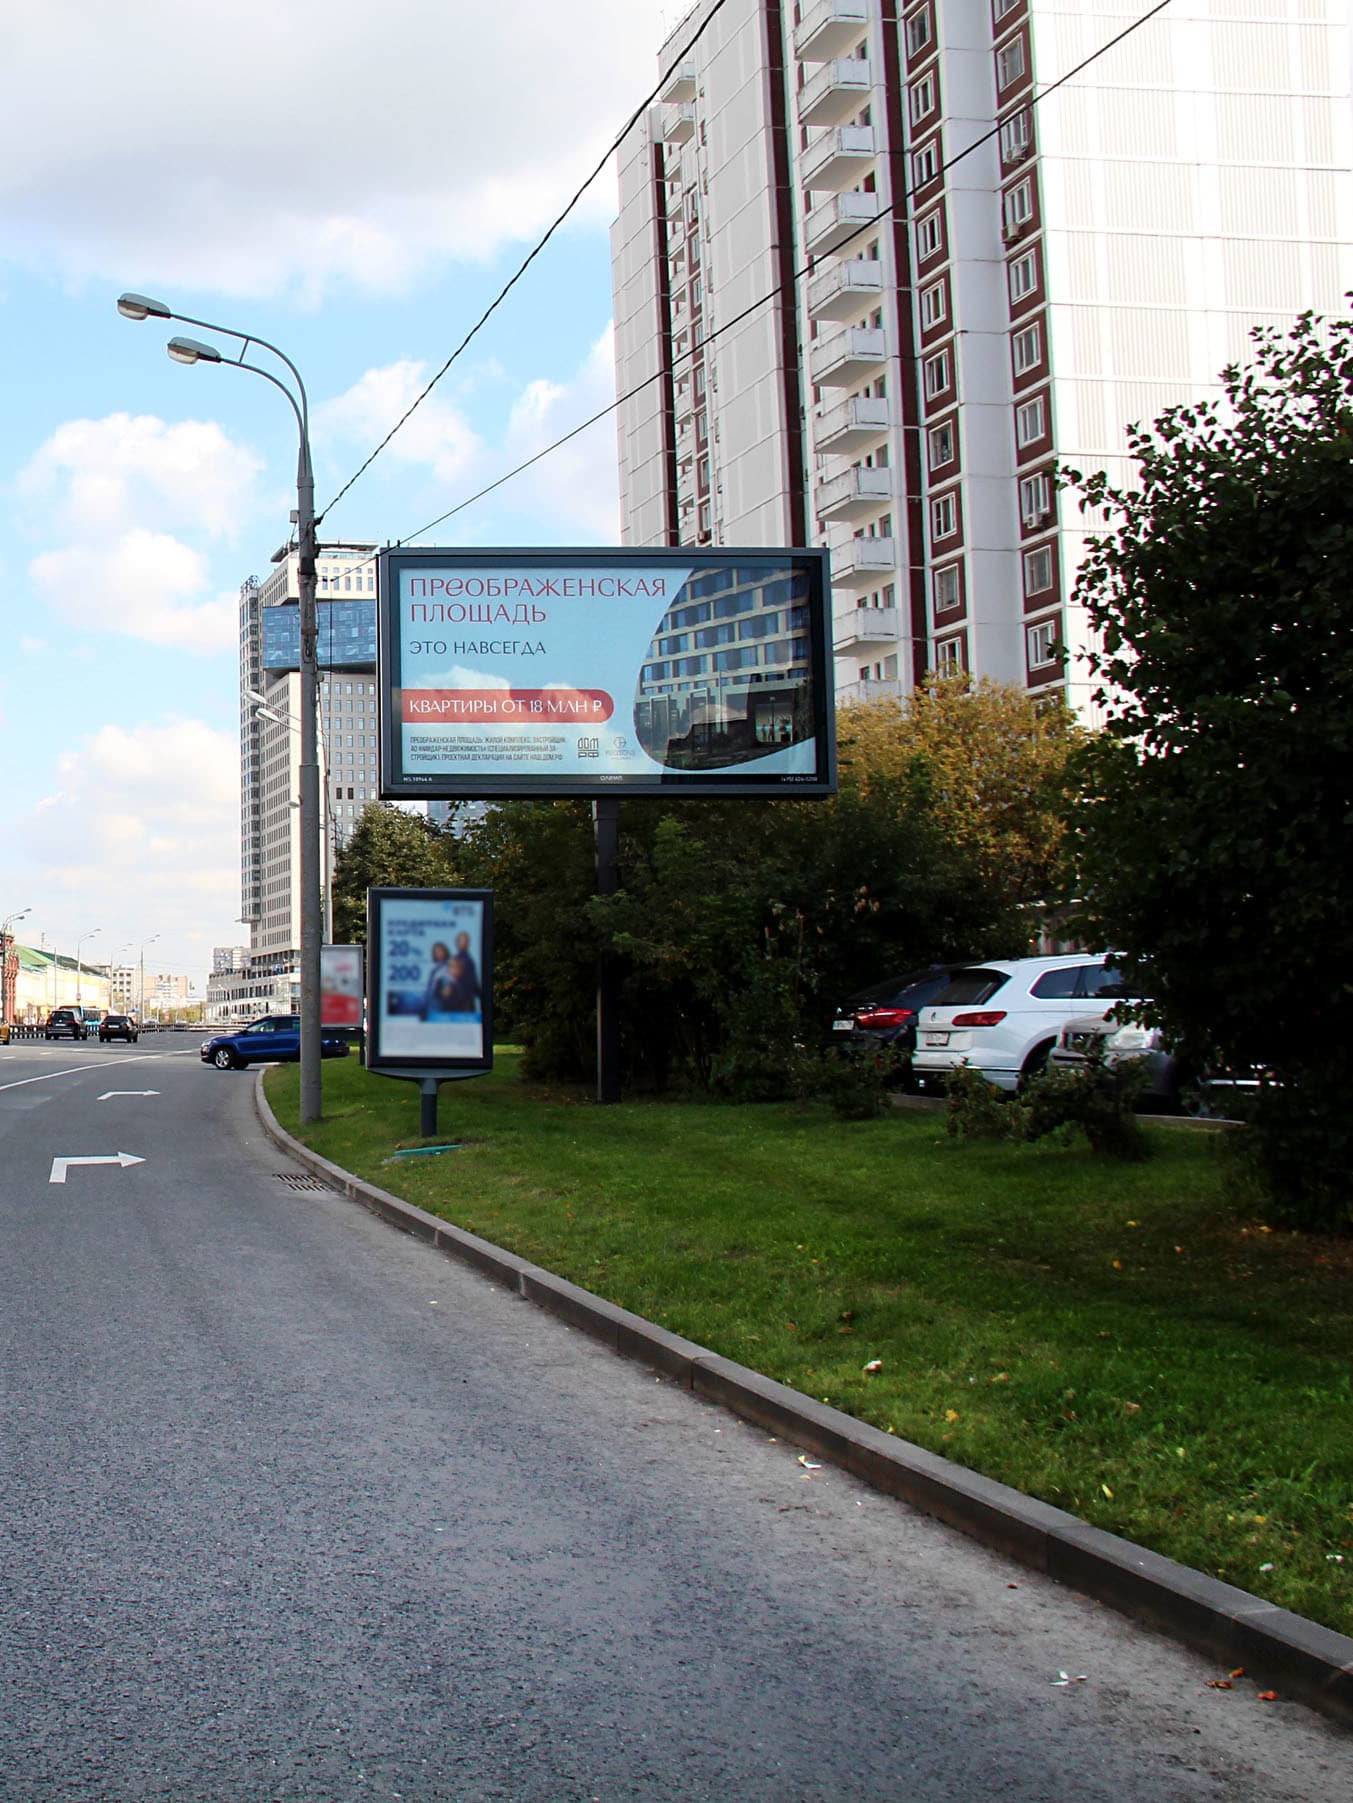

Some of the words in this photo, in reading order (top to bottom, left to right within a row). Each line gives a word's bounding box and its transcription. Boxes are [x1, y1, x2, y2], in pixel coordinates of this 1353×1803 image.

[410, 578, 666, 597] ПРЕОБРАЖЕНСКАЯ
[410, 604, 547, 625] ПЛОЩАДЬ
[410, 641, 447, 655] ЭТО
[453, 641, 547, 656] НАВСЕГДА
[409, 699, 497, 713] КВАРТИРЫ
[501, 699, 526, 713] ОТ
[530, 699, 543, 713] 18
[547, 699, 588, 713] МЛН
[388, 965, 421, 981] 200
